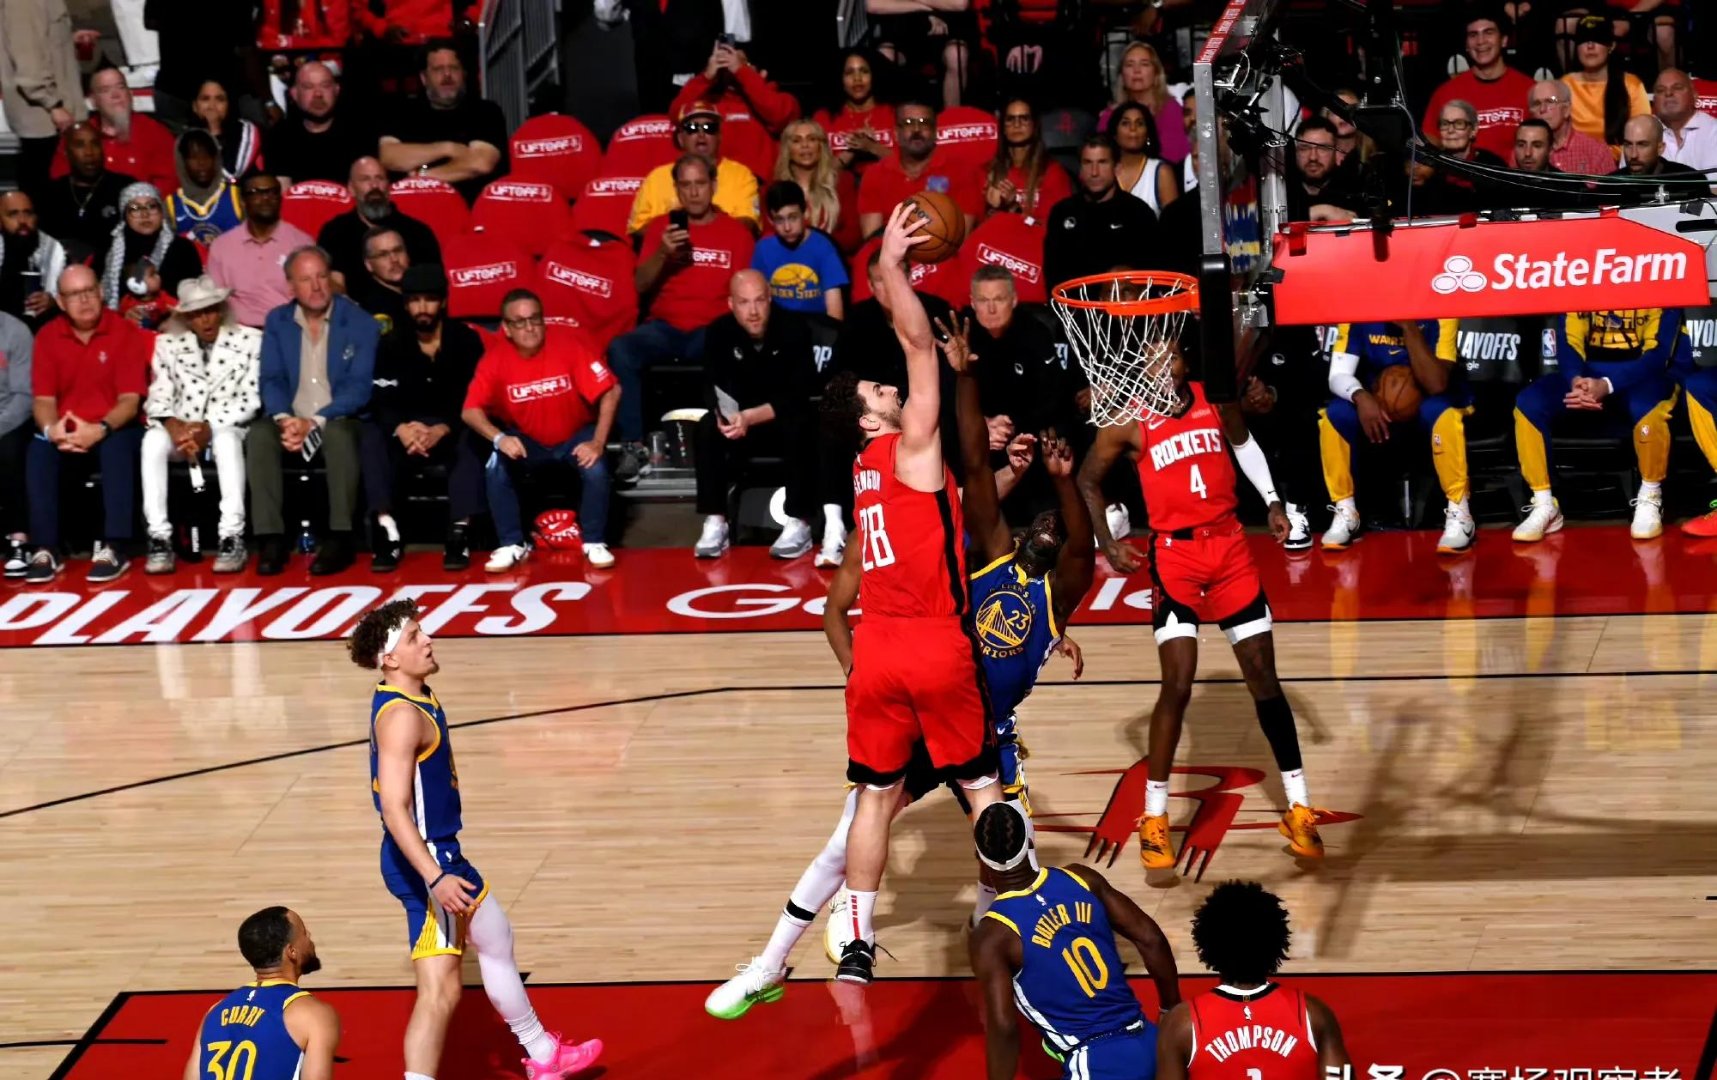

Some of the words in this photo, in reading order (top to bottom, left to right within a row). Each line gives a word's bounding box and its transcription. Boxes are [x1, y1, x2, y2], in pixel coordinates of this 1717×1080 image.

[1150, 428, 1221, 472] ROCKETS
[1190, 464, 1207, 499] 4
[859, 503, 895, 572] 28
[1006, 609, 1030, 631] 23
[1031, 903, 1071, 949] BUTLER
[1075, 901, 1093, 924] III
[1061, 936, 1109, 999] 10
[221, 1004, 266, 1027] CURRY
[207, 1039, 258, 1080] 30
[1204, 1024, 1298, 1063] THOMPSON
